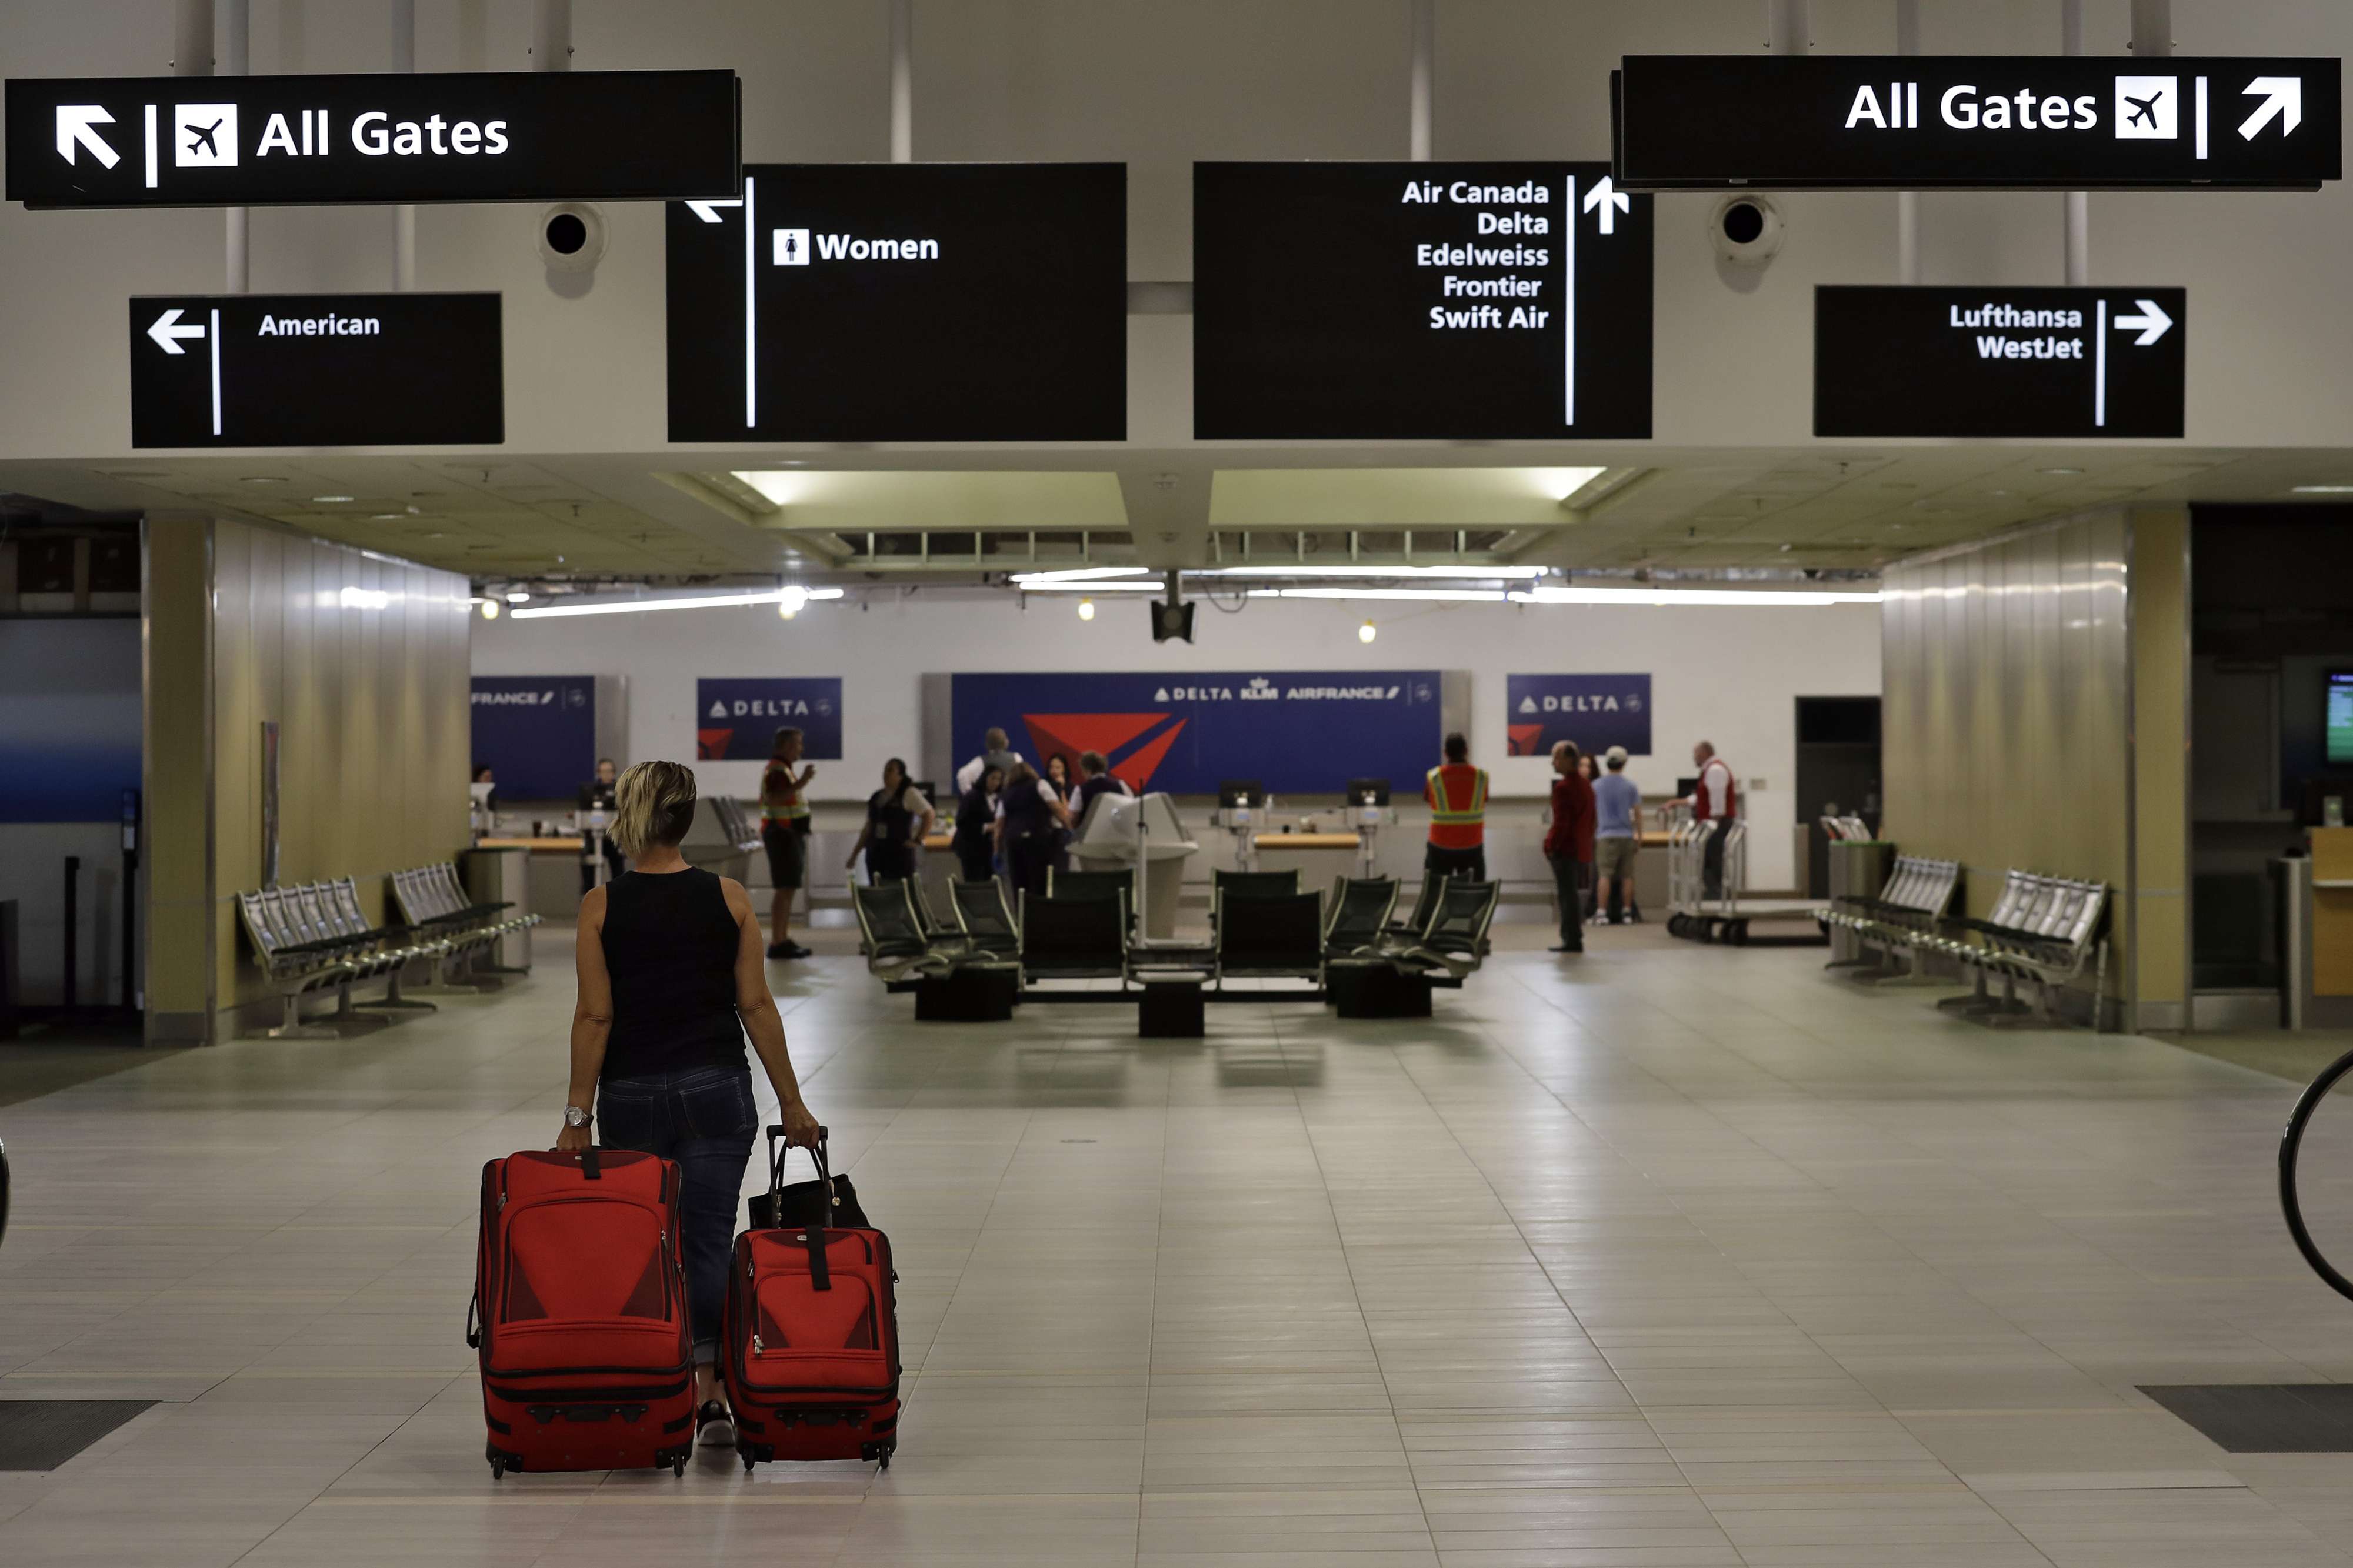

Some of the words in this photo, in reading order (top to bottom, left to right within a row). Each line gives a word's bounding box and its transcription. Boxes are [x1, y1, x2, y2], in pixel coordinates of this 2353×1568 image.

[1844, 82, 1917, 128] All
[1940, 85, 2098, 129] Gates
[256, 109, 329, 156] All
[351, 111, 509, 156] Gates
[1401, 180, 1443, 203] Air
[1449, 180, 1549, 204] Canada
[1478, 211, 1549, 235] Delta
[816, 234, 939, 261] Women
[1417, 242, 1549, 266] Edelweiss
[1444, 275, 1542, 297] Frontier
[258, 313, 380, 336] American
[1429, 305, 1502, 329] Swift
[1508, 305, 1549, 329] Air
[1949, 303, 2083, 328] Lufthansa
[1976, 336, 2083, 359] WestJet
[1172, 687, 1232, 700] DELTA
[1240, 687, 1279, 700] KLM
[1286, 686, 1384, 700] AIRFRANCE
[1542, 695, 1619, 712] DELTA
[734, 699, 809, 716] DELTA
